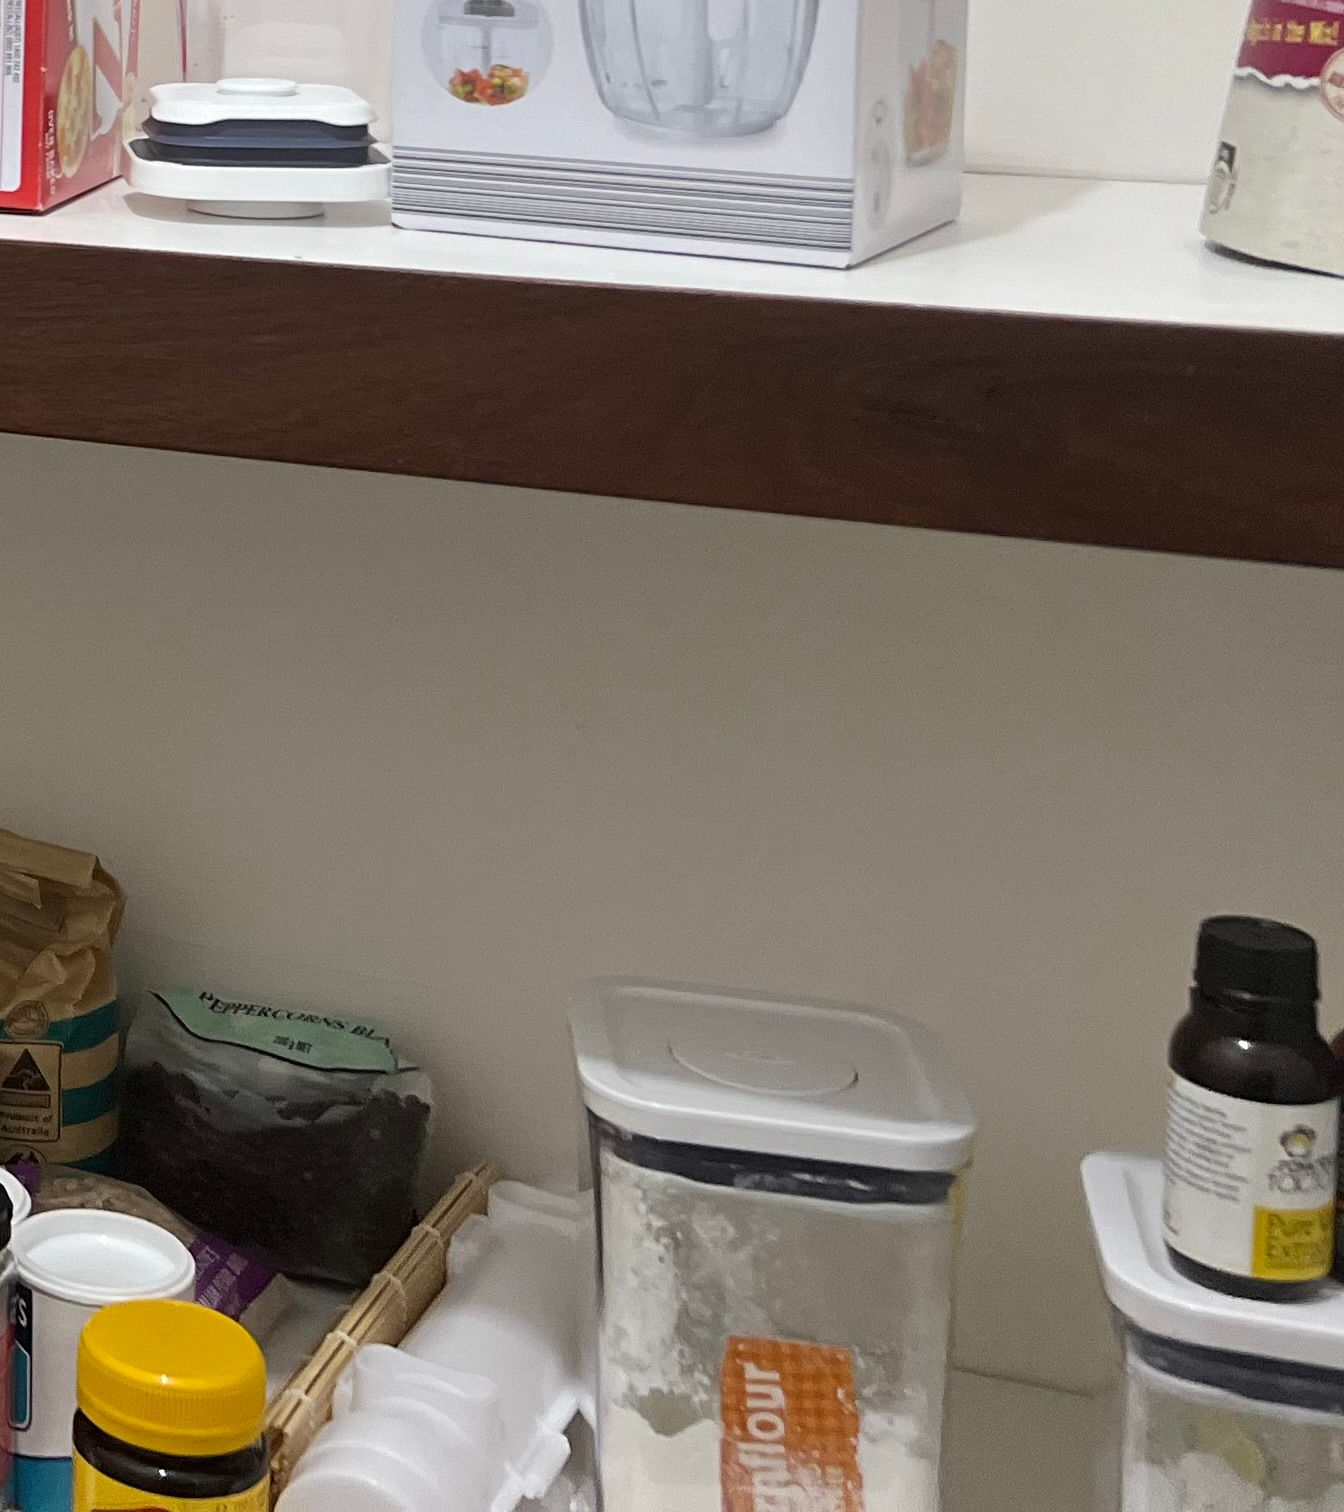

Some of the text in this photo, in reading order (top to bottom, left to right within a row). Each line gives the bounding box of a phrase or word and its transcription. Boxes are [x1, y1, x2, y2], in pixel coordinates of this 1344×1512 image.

[198, 991, 345, 1031] PEPPERCORNS
[42, 1113, 53, 1123] of
[1, 1125, 50, 1137] Australia
